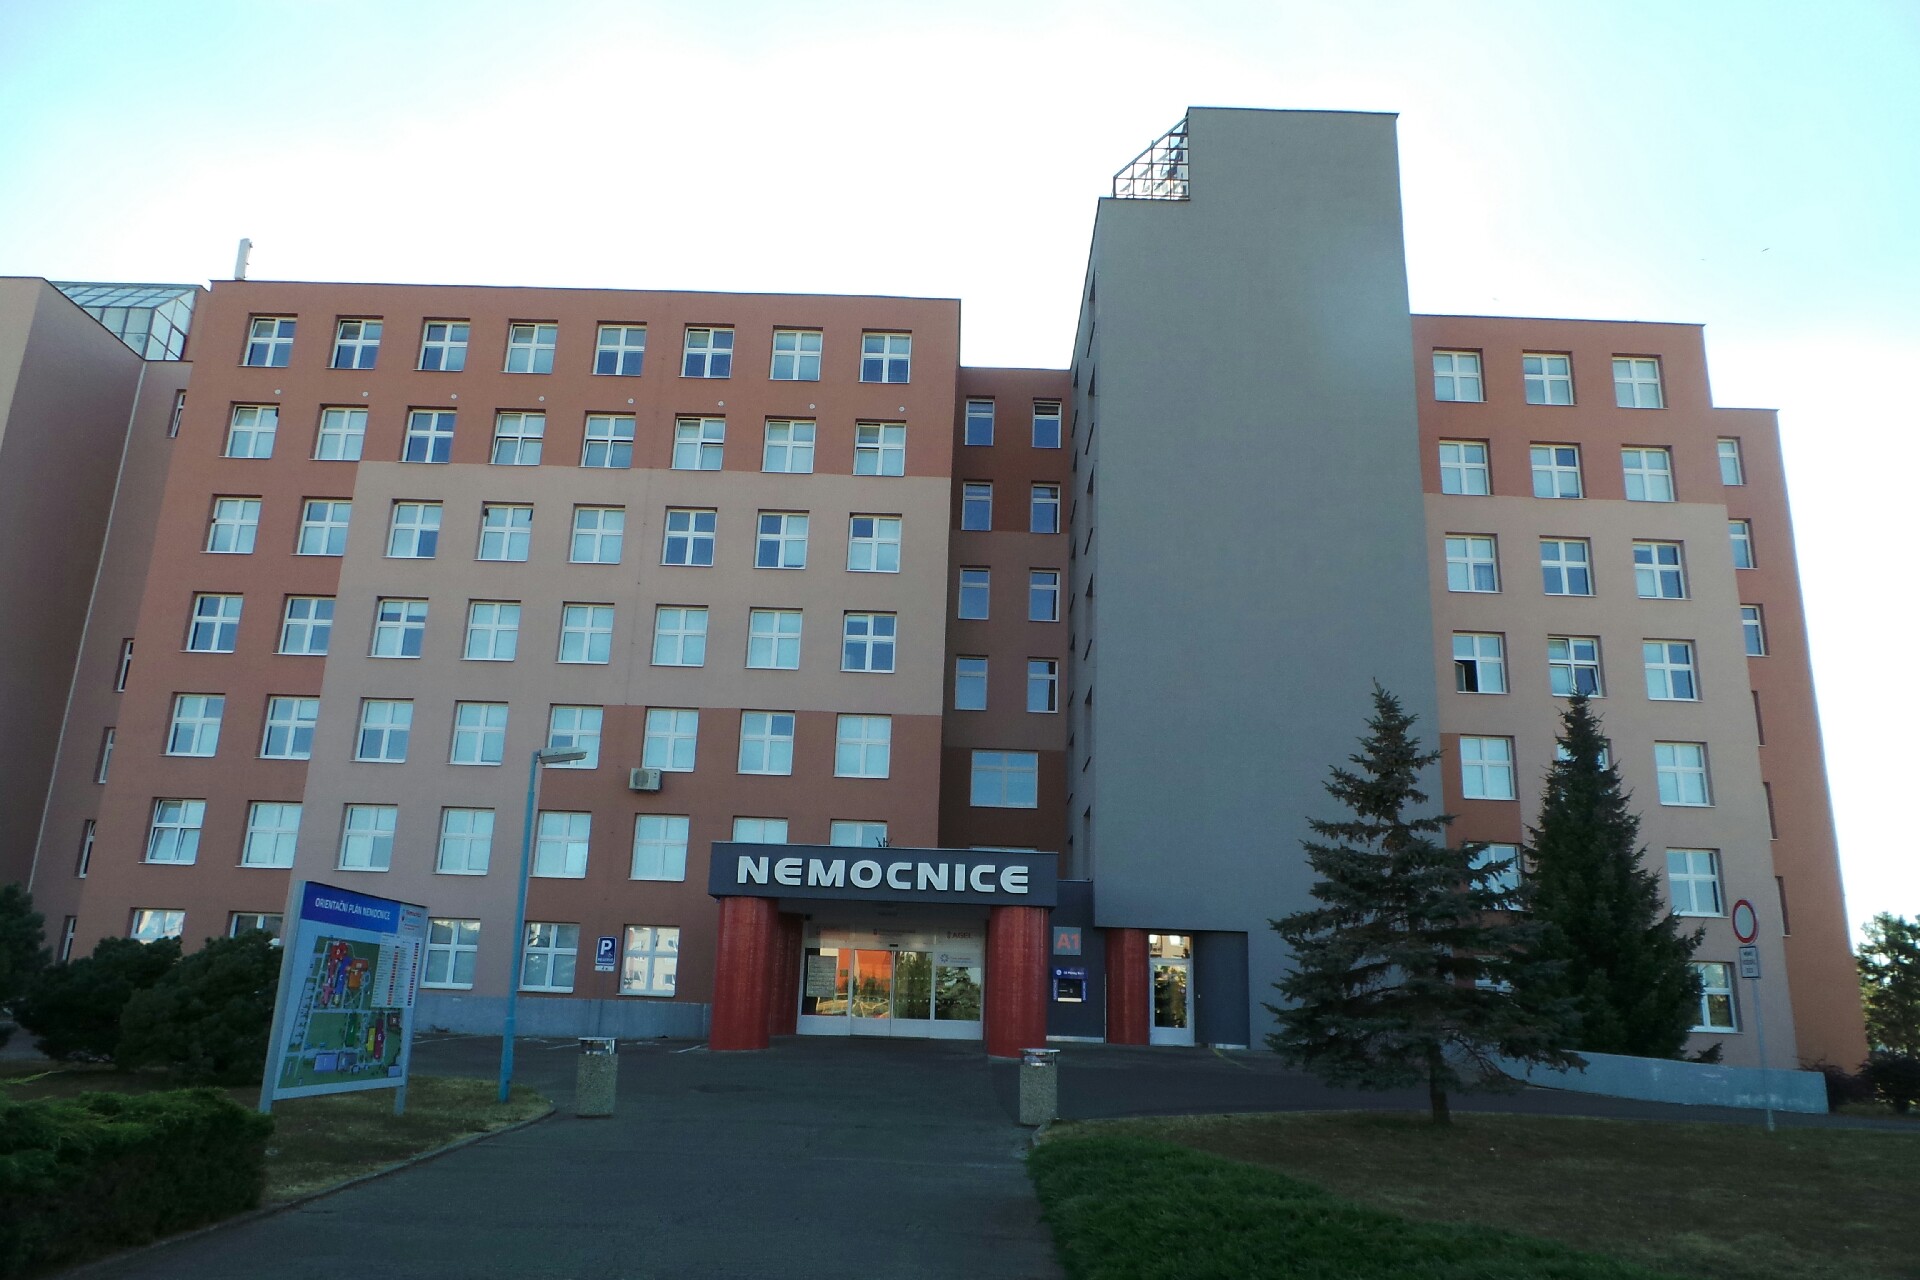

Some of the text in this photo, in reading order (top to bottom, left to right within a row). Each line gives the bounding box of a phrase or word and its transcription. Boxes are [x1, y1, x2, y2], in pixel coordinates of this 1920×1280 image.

[737, 855, 1029, 894] NEMOCNICE
[315, 897, 348, 913] ORIENTAČNÍ
[348, 903, 362, 915] PLÁN
[600, 940, 612, 955] P
[1057, 932, 1080, 949] A1
